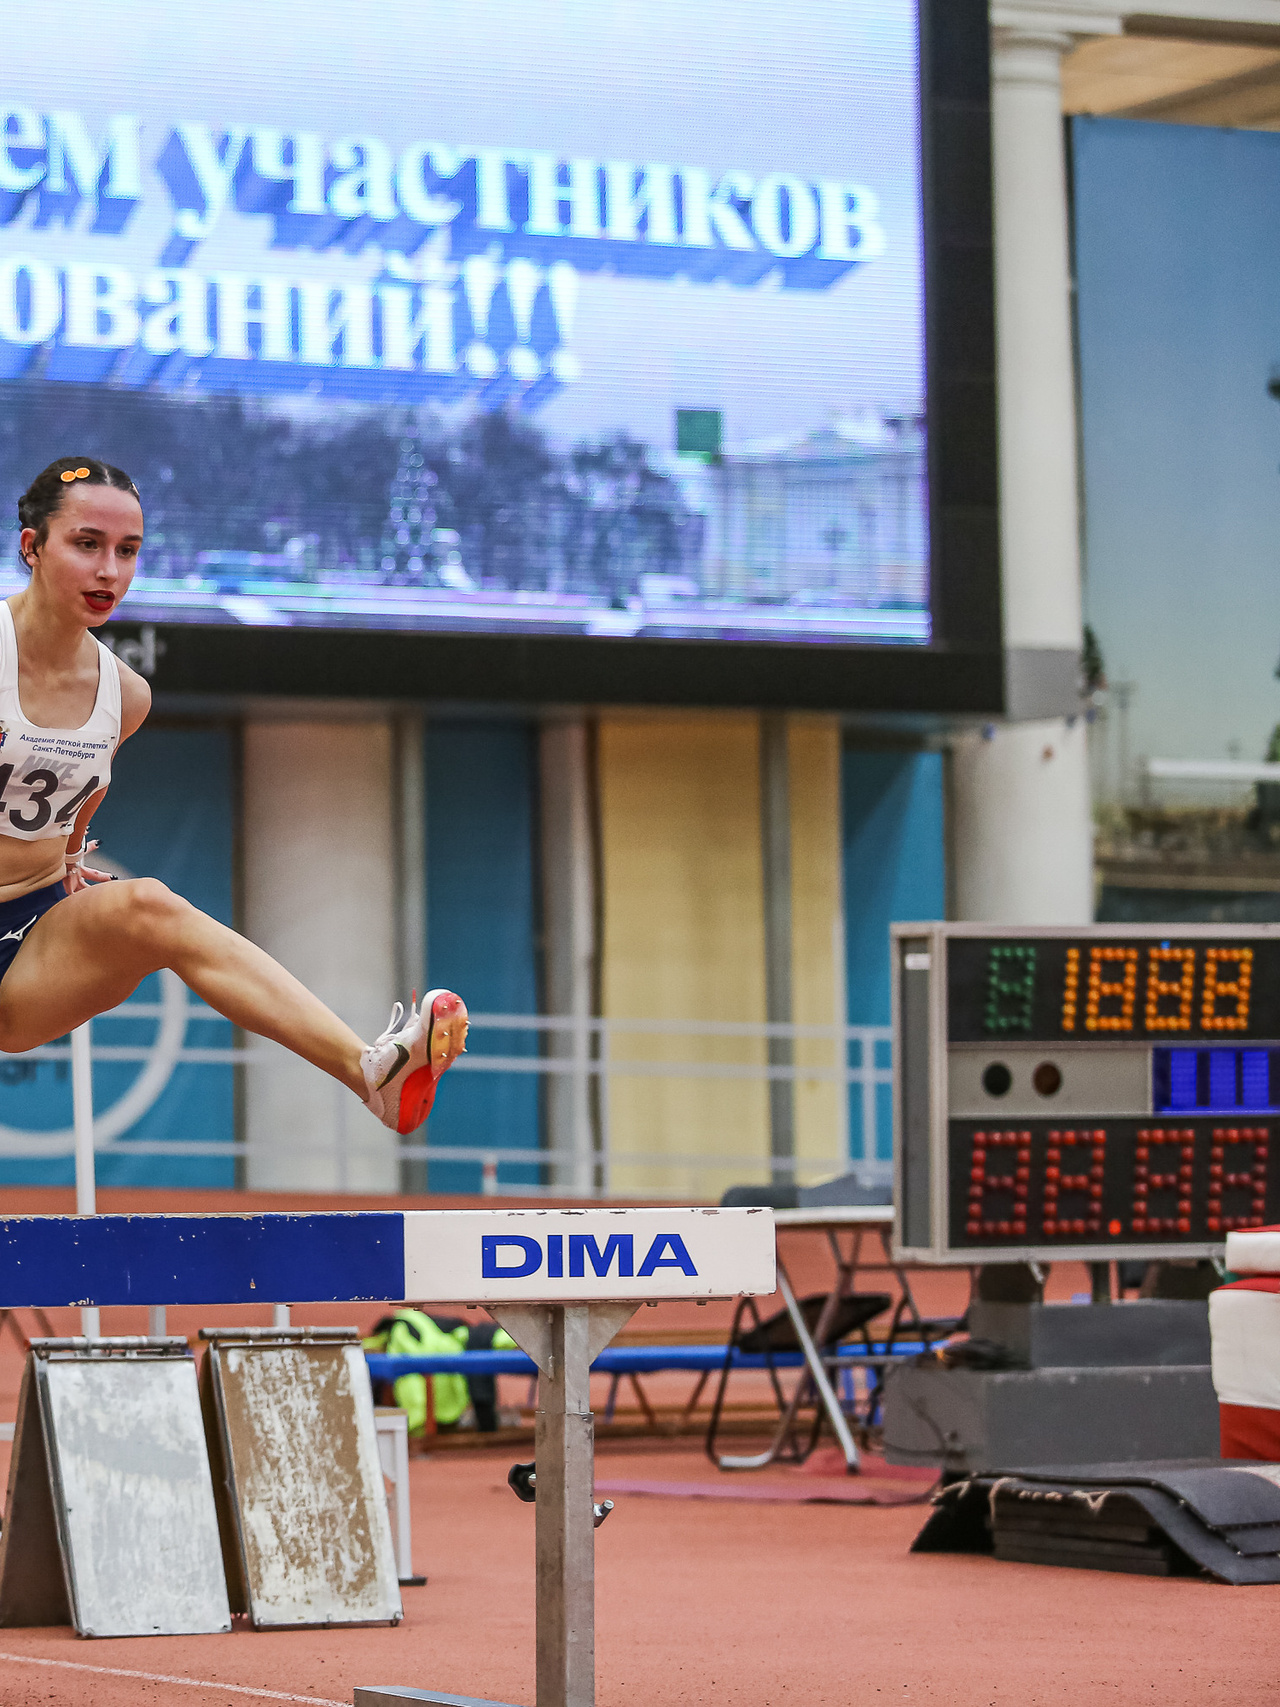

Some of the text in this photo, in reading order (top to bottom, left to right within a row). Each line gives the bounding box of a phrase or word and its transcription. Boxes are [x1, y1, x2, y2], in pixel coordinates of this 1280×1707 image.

[169, 117, 886, 263] участников
[19, 733, 109, 751] Академия легкой атлетики
[32, 744, 96, 760] Санкт-Петербурга
[481, 1233, 699, 1279] DIMA
